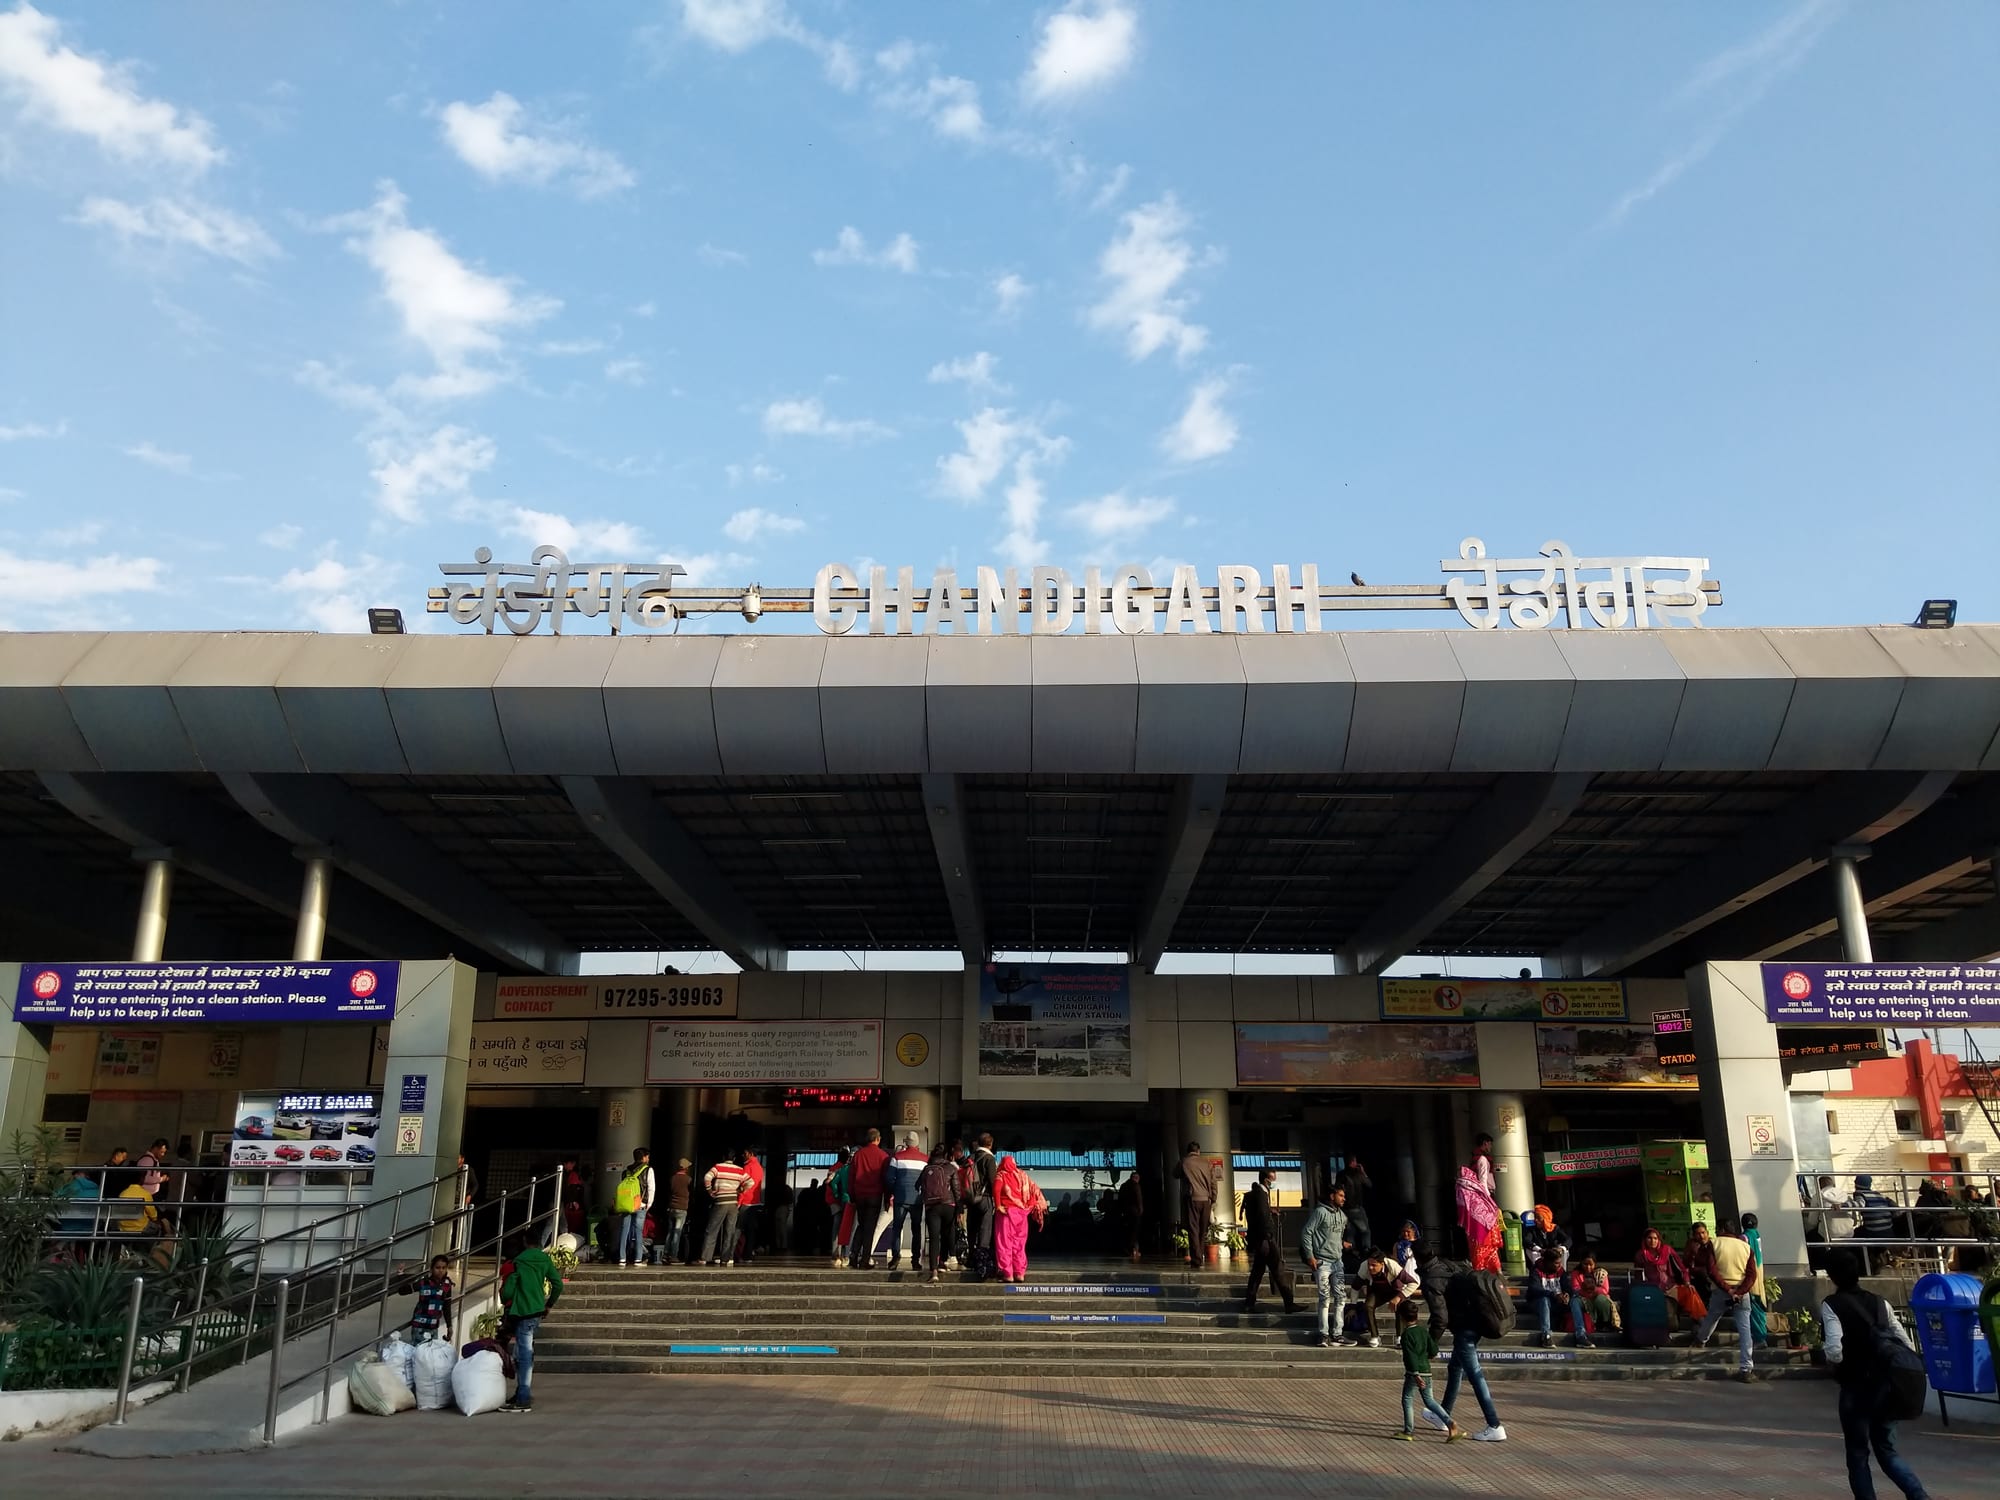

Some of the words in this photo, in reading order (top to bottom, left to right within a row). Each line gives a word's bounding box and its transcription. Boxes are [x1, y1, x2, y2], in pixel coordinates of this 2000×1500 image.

[813, 563, 1323, 634] CHANDIGARH
[77, 969, 102, 977] आप
[103, 969, 125, 979] एक
[126, 969, 158, 977] स्वच्छ
[159, 967, 196, 977] स्टेशन
[197, 967, 210, 977] में
[211, 967, 243, 977] प्रवेश
[243, 969, 264, 977] कर
[265, 966, 281, 977] रहे
[1824, 969, 1850, 978] आप
[1851, 969, 1873, 979] एक
[1875, 969, 1908, 977] स्वच्छ
[1910, 967, 1948, 977] स्टेशन
[1949, 967, 1961, 977] में
[1964, 967, 1997, 978] प्रवेश
[75, 979, 94, 991] इसे
[95, 982, 129, 990] स्वच्छ
[129, 979, 160, 990] रखने
[161, 979, 174, 990] में
[173, 979, 208, 991] हमारी
[208, 982, 236, 990] मदद
[499, 984, 589, 998] ADVERTISEMENT
[1825, 980, 1846, 992] इसे
[1847, 982, 1881, 991] स्वच्छ
[1882, 980, 1914, 990] रखने
[1915, 980, 1927, 991] में
[1928, 980, 1963, 991] हमारी
[1964, 982, 1993, 990] मदद
[73, 994, 95, 1004] You
[98, 996, 118, 1004] are
[121, 994, 170, 1007] entering
[172, 994, 195, 1004] into
[197, 996, 206, 1004] a
[208, 994, 239, 1004] clean
[242, 994, 285, 1004] station.
[287, 993, 327, 1004] Please
[603, 986, 724, 1009] 97295-39963
[1053, 994, 1097, 1002] WELCOME
[1827, 995, 1851, 1005] You
[1854, 997, 1876, 1005] are
[1878, 994, 1929, 1007] entering
[1931, 994, 1955, 1005] into
[1958, 997, 1967, 1005] a
[1969, 994, 2000, 1005] clean
[70, 1006, 96, 1019] help
[99, 1009, 112, 1017] us
[115, 1007, 127, 1017] to
[129, 1006, 159, 1019] keep
[162, 1006, 171, 1017] it
[172, 1006, 207, 1017] clean.
[504, 1001, 554, 1013] CONTACT
[1042, 1011, 1082, 1019] RAILWAY
[1085, 1011, 1122, 1019] STATION
[1654, 1013, 1671, 1021] Train
[1829, 1008, 1856, 1020] help
[1859, 1010, 1873, 1018] us
[1875, 1008, 1888, 1018] to
[1891, 1007, 1922, 1020] keep
[1924, 1007, 1933, 1018] it
[1936, 1007, 1972, 1018] clean.
[673, 1030, 689, 1038] For
[691, 1031, 707, 1039] any
[709, 1030, 749, 1038] business
[751, 1031, 776, 1039] query
[778, 1030, 821, 1039] regarding
[775, 1040, 819, 1048] Corporate
[661, 1050, 681, 1058] CSR
[683, 1050, 715, 1058] activity
[747, 1049, 798, 1058] Chandigarh
[800, 1049, 834, 1058] Railway
[692, 1060, 717, 1068] Kindly
[759, 1060, 793, 1068] following
[283, 1096, 322, 1110] MOTI
[324, 1095, 374, 1109] SAGAR
[1562, 1149, 1616, 1161] ADVERTISE
[1552, 1160, 1599, 1172] CONTACT
[1491, 1352, 1514, 1360] PLEDGE
[1514, 1352, 1526, 1360] FOR
